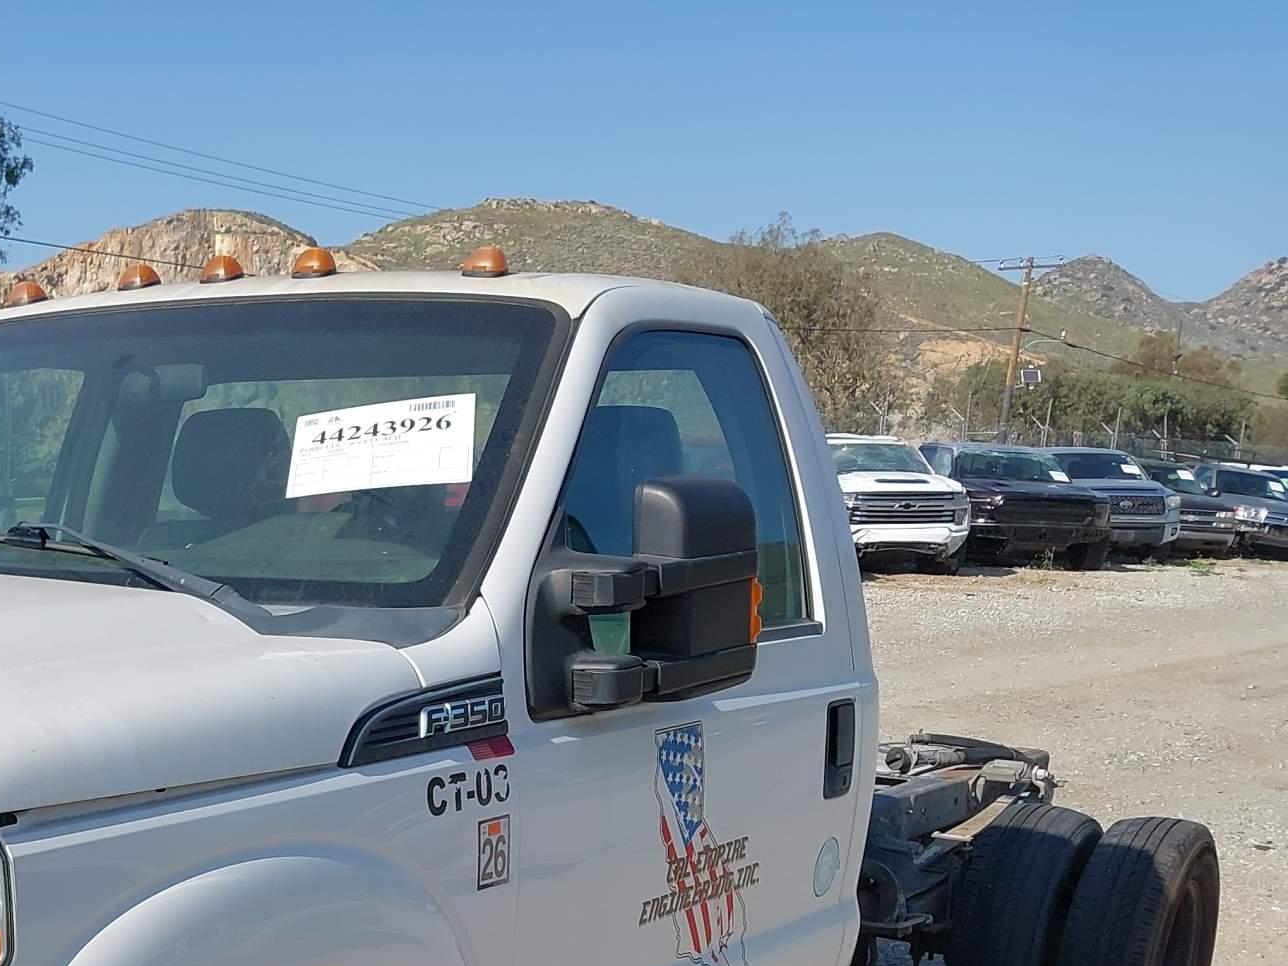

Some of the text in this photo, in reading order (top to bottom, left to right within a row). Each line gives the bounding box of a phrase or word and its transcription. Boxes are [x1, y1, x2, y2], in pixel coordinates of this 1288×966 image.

[312, 414, 456, 445] 44243926
[420, 697, 505, 738] F-350
[426, 764, 511, 817] CT-03
[481, 834, 507, 882] 26
[666, 836, 749, 883] CAL EMPIRE
